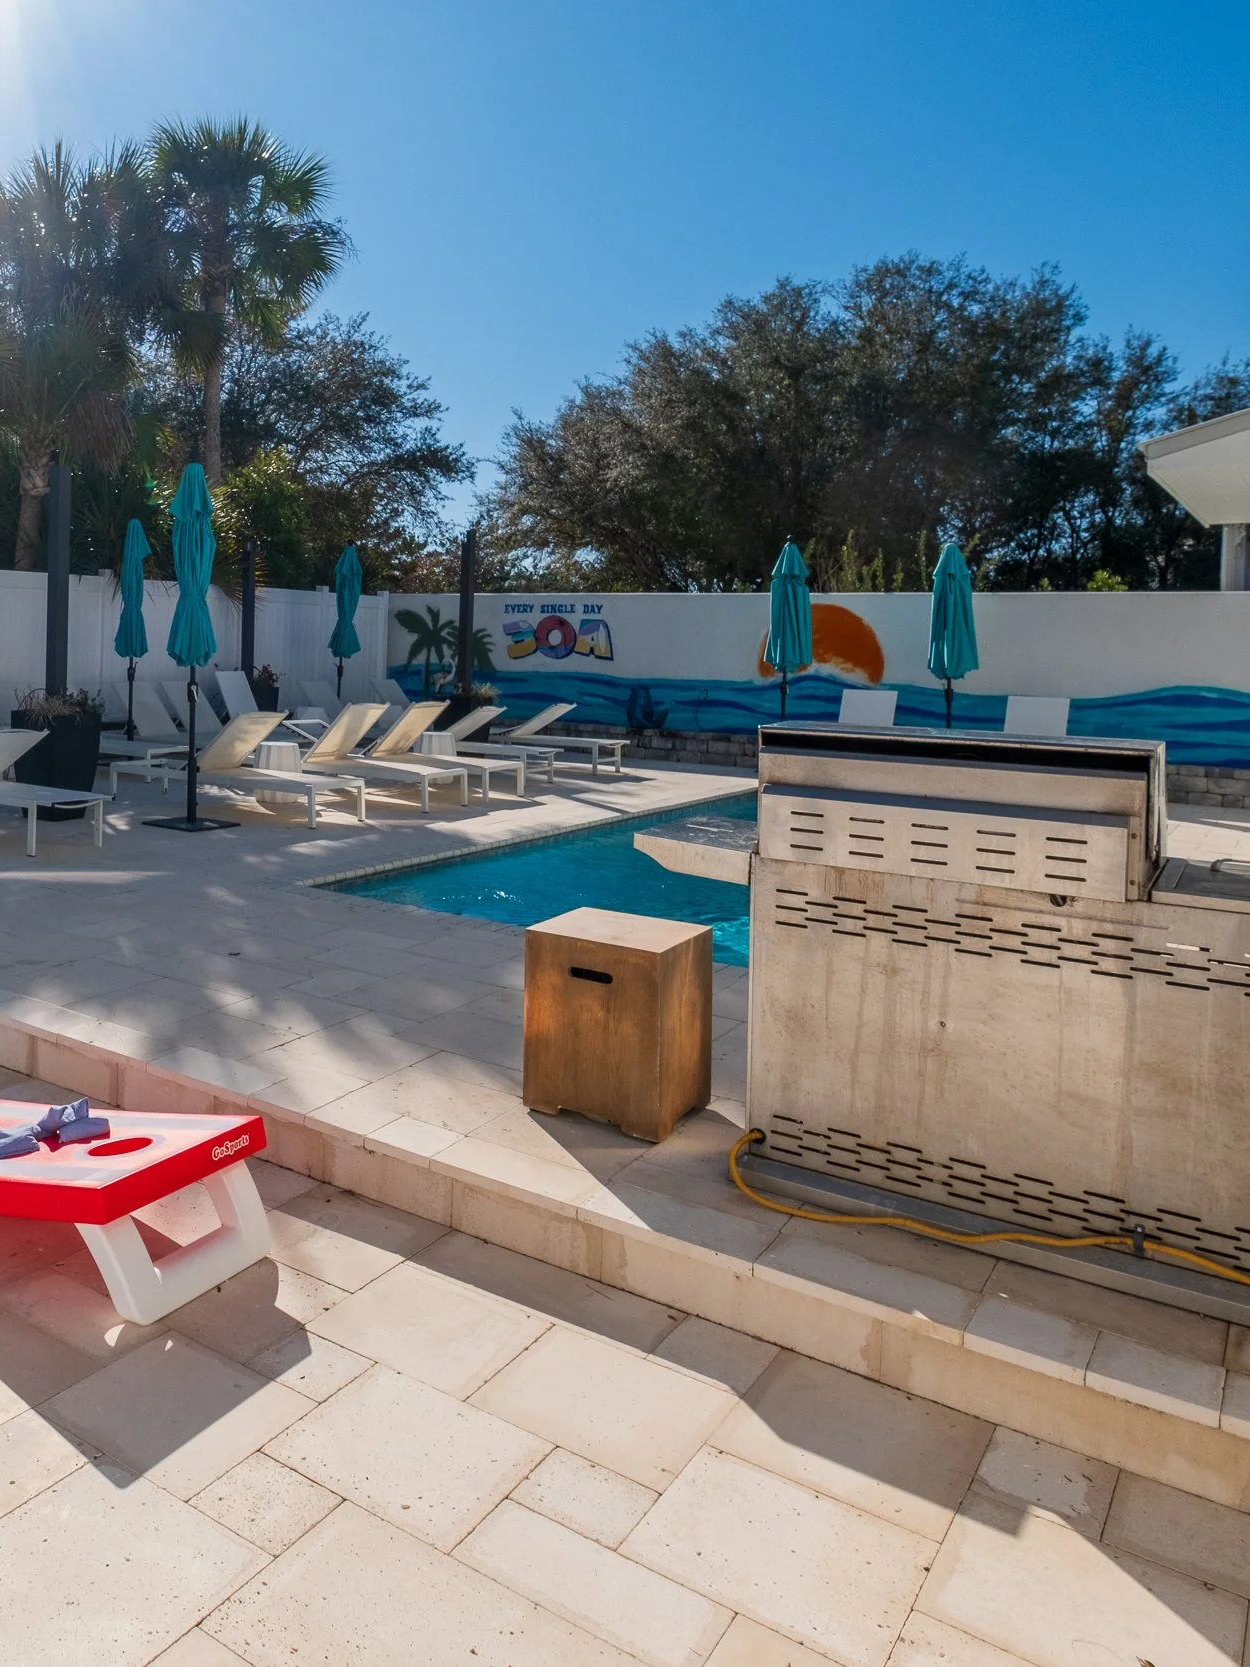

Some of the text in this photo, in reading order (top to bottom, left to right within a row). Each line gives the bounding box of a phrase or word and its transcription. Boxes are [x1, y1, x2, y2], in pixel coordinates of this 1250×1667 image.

[504, 604, 604, 614] EVERY SINGLE DAY
[212, 1133, 250, 1160] GoSports
